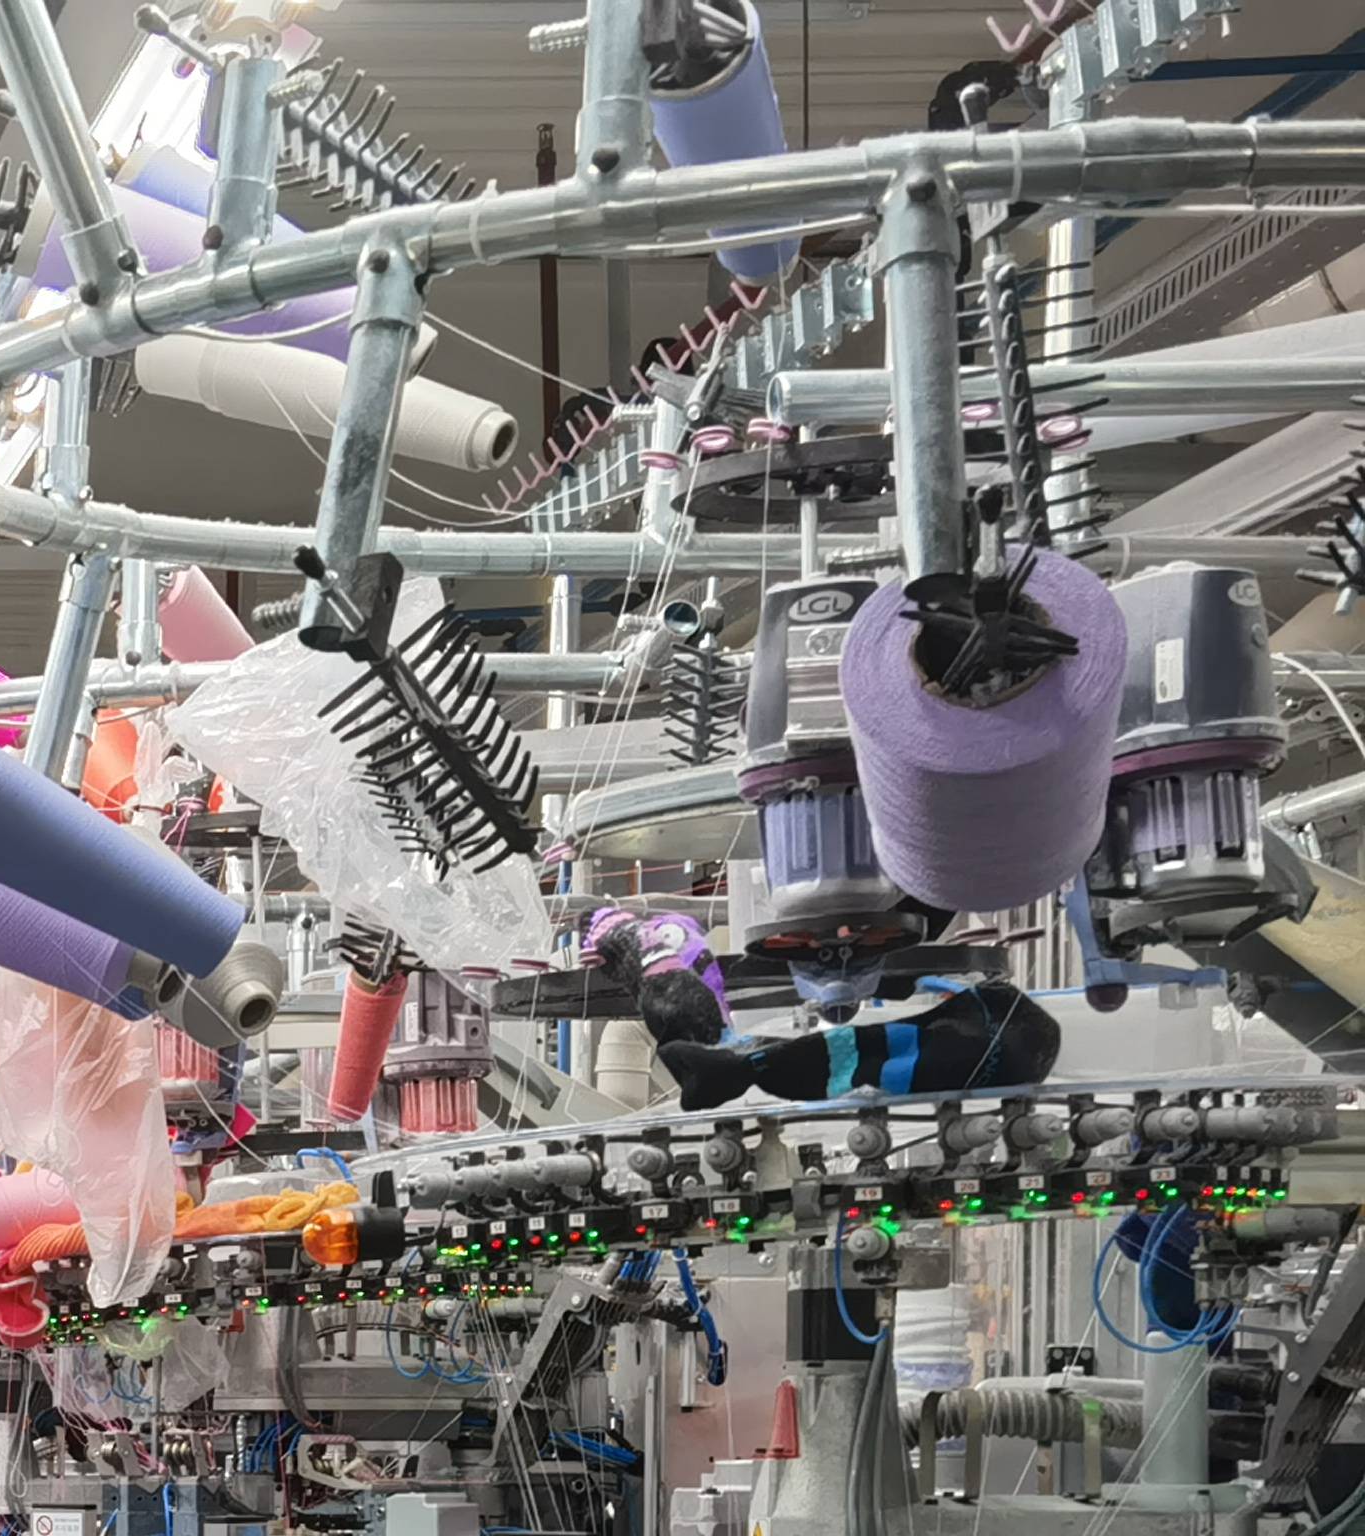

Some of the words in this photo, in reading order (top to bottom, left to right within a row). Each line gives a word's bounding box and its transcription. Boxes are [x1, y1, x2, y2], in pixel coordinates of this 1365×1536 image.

[797, 596, 843, 615] LGL
[1092, 1174, 1107, 1183] 22
[1156, 1171, 1171, 1180] 23
[1025, 1178, 1040, 1187] 21
[960, 1183, 975, 1192] 20
[861, 1189, 878, 1199] 19
[720, 1201, 735, 1211] 18
[648, 1207, 663, 1217] 17
